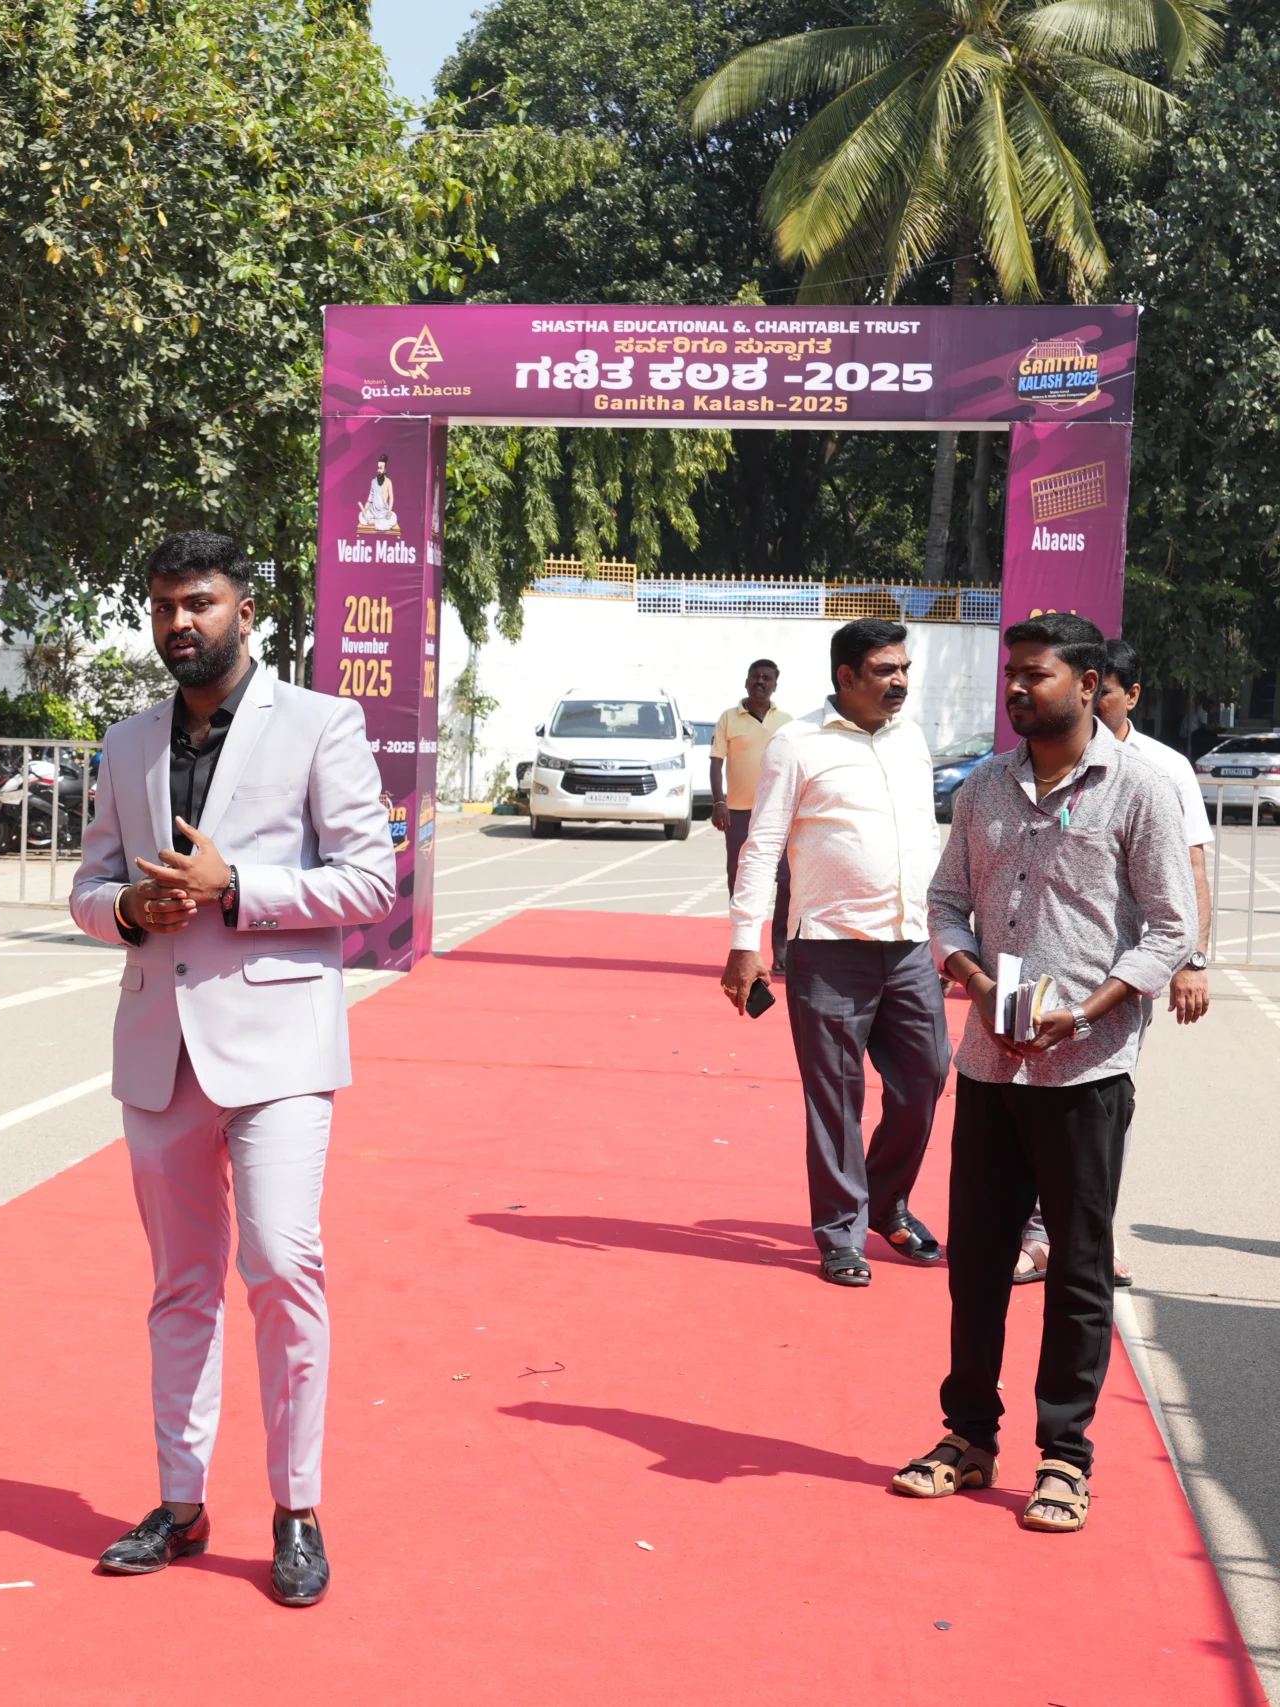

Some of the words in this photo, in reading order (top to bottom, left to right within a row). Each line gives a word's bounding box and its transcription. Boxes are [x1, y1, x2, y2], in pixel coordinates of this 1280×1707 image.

[532, 320, 609, 333] SHASTHA
[613, 320, 728, 333] EDUCATIONAL
[755, 321, 859, 333] CHARITABLE
[864, 321, 921, 333] TRUST
[615, 336, 727, 353] ಸರ್ವರಿಗೂ
[734, 337, 832, 362] ಸುಸ್ವಾಗತ
[516, 349, 634, 390] ಗಣಿತ
[648, 356, 768, 390] ಕಲಶ
[784, 362, 933, 392] -2025
[1019, 354, 1098, 375] GANITHA
[361, 384, 410, 399] Quick
[412, 384, 471, 396] Abacus
[1018, 374, 1063, 391] KALASH
[1065, 370, 1098, 388] 2025
[594, 394, 685, 411] Ganitha
[694, 395, 848, 412] Kalash-2025
[1032, 527, 1085, 551] Abacus
[338, 539, 372, 563] Vedic
[375, 540, 416, 564] Maths
[344, 596, 392, 634] 20th
[341, 636, 389, 654] November
[339, 659, 392, 697] 2025
